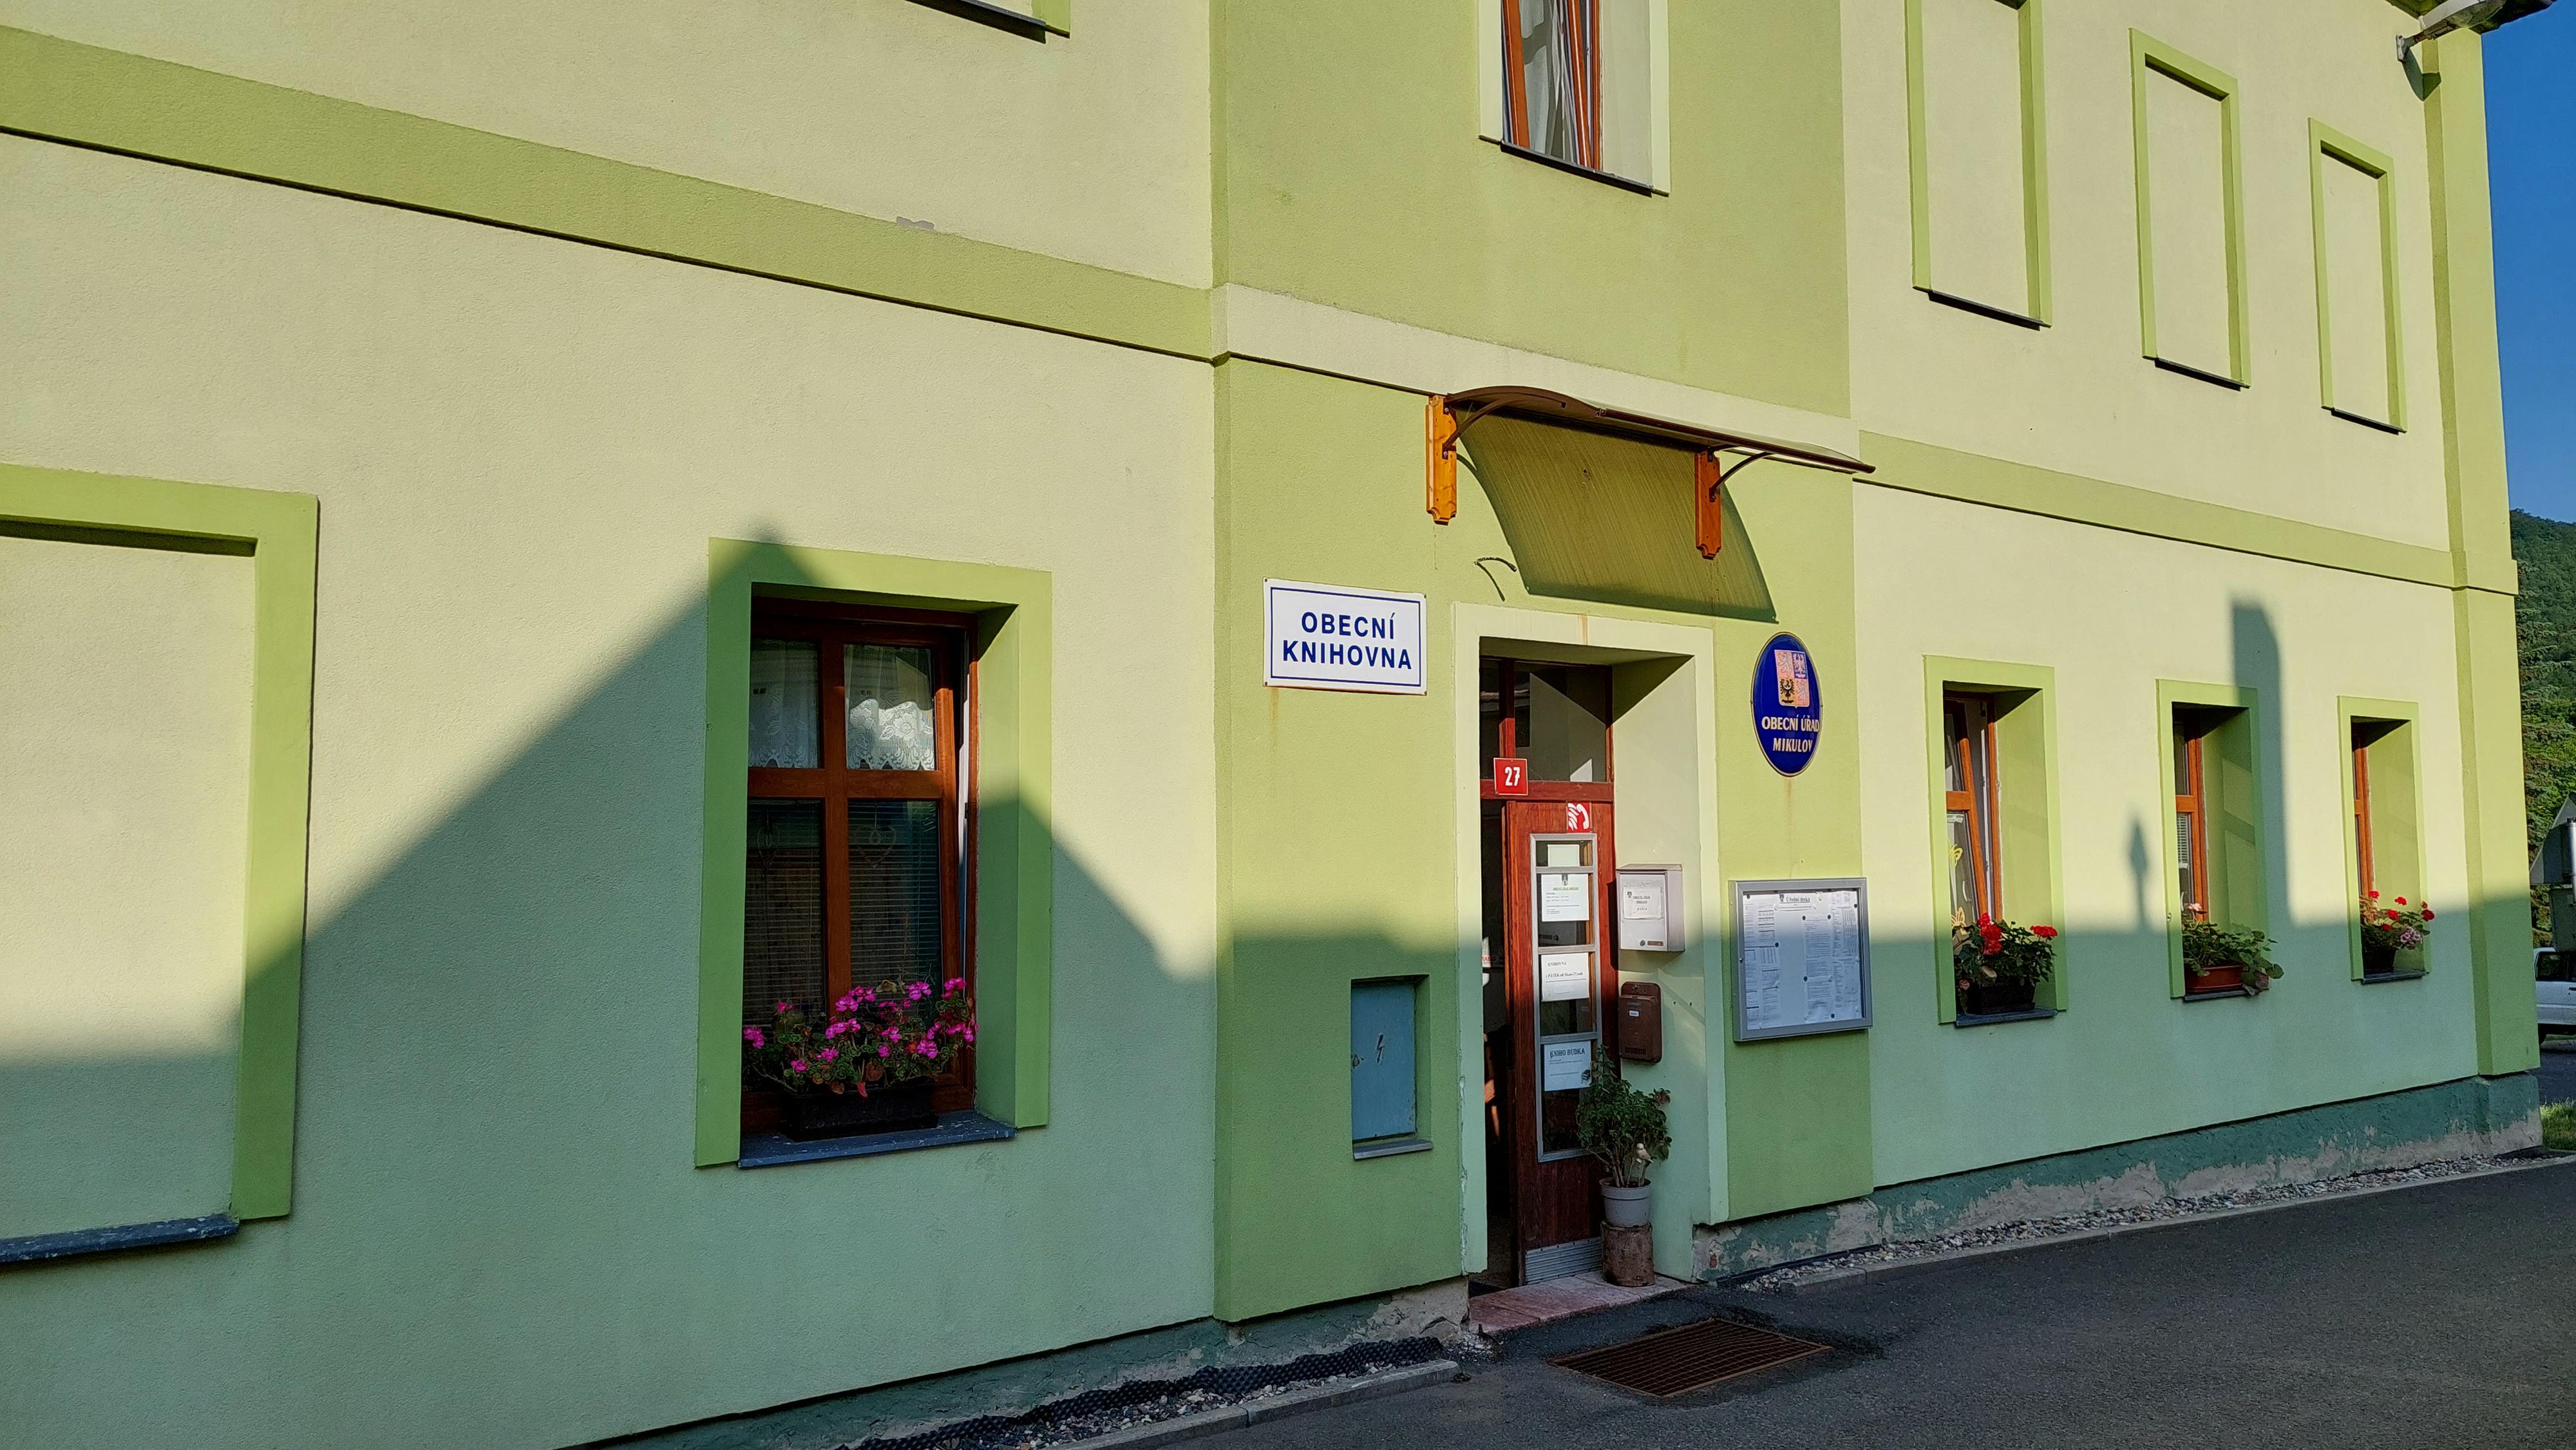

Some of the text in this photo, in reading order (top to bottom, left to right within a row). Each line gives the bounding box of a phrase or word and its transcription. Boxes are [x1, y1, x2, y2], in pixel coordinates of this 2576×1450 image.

[1301, 612, 1396, 640] OBECNÍ
[1283, 639, 1412, 670] KNIHOVNA
[1761, 714, 1820, 732] OBECNÍ ÚŘAD
[1772, 737, 1813, 753] MIKULOV
[1504, 766, 1520, 787] 27
[1567, 1048, 1586, 1056] BUDKA
